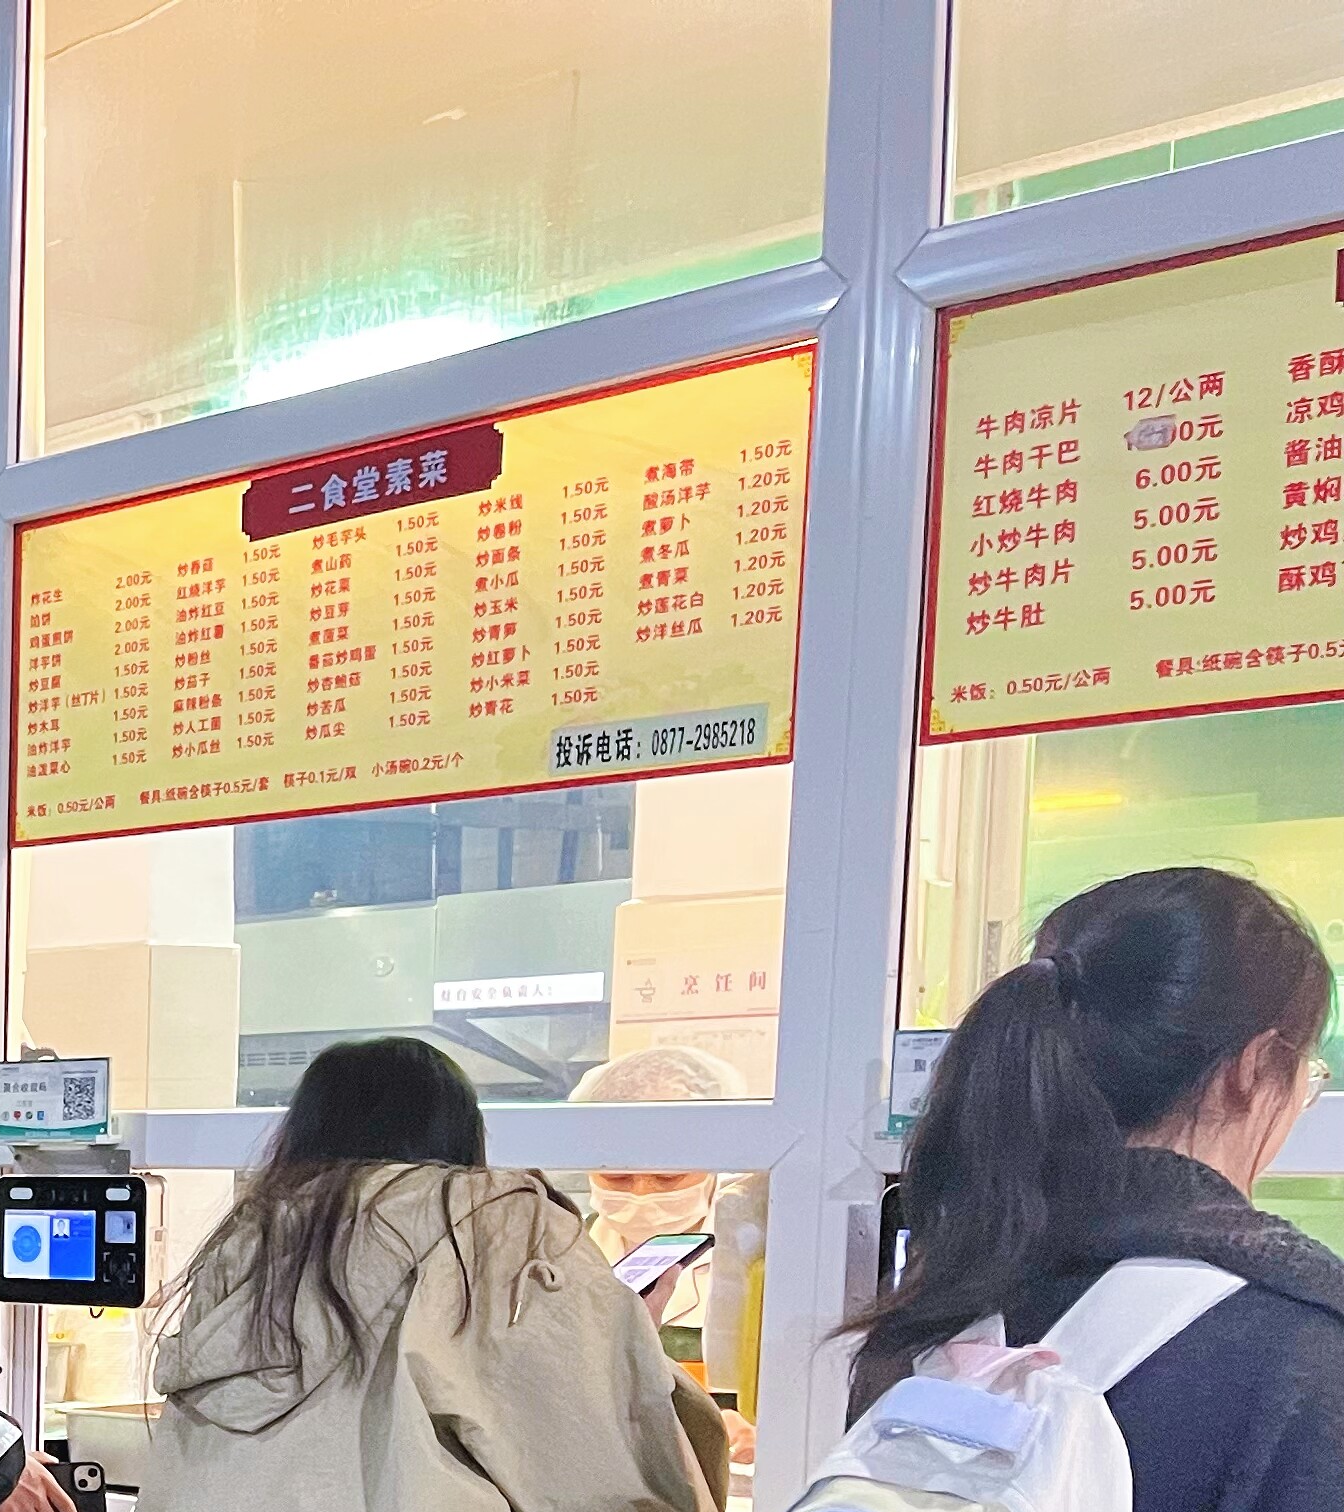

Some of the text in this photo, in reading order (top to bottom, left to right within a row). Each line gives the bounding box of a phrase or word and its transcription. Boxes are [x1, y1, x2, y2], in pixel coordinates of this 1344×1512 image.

[977, 400, 1079, 439] 牛肉凉片
[1125, 371, 1225, 410] 12/公两
[975, 389, 1344, 476] 牛肉干巴 凉鸡
[644, 439, 791, 483] 煮海带 1.50元
[973, 435, 1343, 517] 红烧牛肉 6.00元 酱油
[289, 450, 448, 514] 二食堂素菜
[563, 477, 609, 497] 1.50元
[641, 468, 789, 510] 酸汤洋芋 1.20元
[560, 504, 608, 525] 1.50元
[641, 496, 788, 537] 煮萝卜 1.20元
[972, 477, 1342, 556] 小炒牛肉 5.00元 黄焖
[313, 512, 439, 549] 炒毛芋头 1.50元
[640, 523, 787, 564] 煮冬瓜 1.20元
[243, 545, 280, 562] 1.50元
[311, 536, 438, 575] 煮山药 1.50元
[474, 529, 607, 568] 炒面条 1.50元
[968, 519, 1344, 595] 炒牛肉片 5.00元 炒鸡
[115, 571, 152, 589] 2.00元
[177, 568, 279, 600] 红烧洋芋 1.50元
[311, 561, 437, 598] 炒花菜 1.50元
[474, 555, 607, 592] 煮小瓜 1.50元
[639, 551, 784, 590] 煮青菜 1.20元
[115, 593, 150, 611] 2.00元
[176, 592, 278, 622] 油炸红豆 1.50元
[309, 587, 436, 622] 炒豆芽 1.50元
[472, 582, 603, 617] 炒玉米 1.50元
[636, 579, 783, 615] 炒莲花白 1.20元
[966, 561, 1344, 635] 炒牛肚 5.00元 酥鸡
[115, 616, 150, 633] 2.00元
[242, 615, 278, 631] 1.50元
[392, 610, 434, 630] 1.50元
[555, 608, 602, 628] 1.50元
[635, 606, 782, 644] 炒洋丝瓜 1.20元
[115, 638, 149, 655] 2.00元
[175, 639, 277, 667] 炒粉丝 1.50元
[392, 636, 432, 655] 1.50元
[470, 634, 602, 669] 炒红萝卜 1.50元
[116, 660, 149, 675] 1.50元
[240, 662, 276, 678] 1.50元
[391, 661, 432, 677] 1.50元
[469, 661, 598, 693] 炒小米菜 1.50元
[115, 683, 148, 698] 1.50元
[240, 685, 275, 700] 1.50元
[306, 685, 431, 717] 炒苦瓜 1.50元
[552, 687, 598, 704] 1.50元
[28, 708, 148, 732] 炒木耳 1.50元
[239, 709, 273, 725] 1.50元
[304, 710, 431, 741] 炒瓜尖 1.50元
[27, 729, 148, 757] 油炸洋芋 1.50元
[113, 750, 145, 764] 1.50元
[171, 732, 273, 759] 炒小瓜丝 1.50元
[282, 764, 357, 788] 筷子0.1元/双
[372, 752, 464, 777] 小汤碗0.2元/个
[681, 971, 767, 995] 烹饪间
